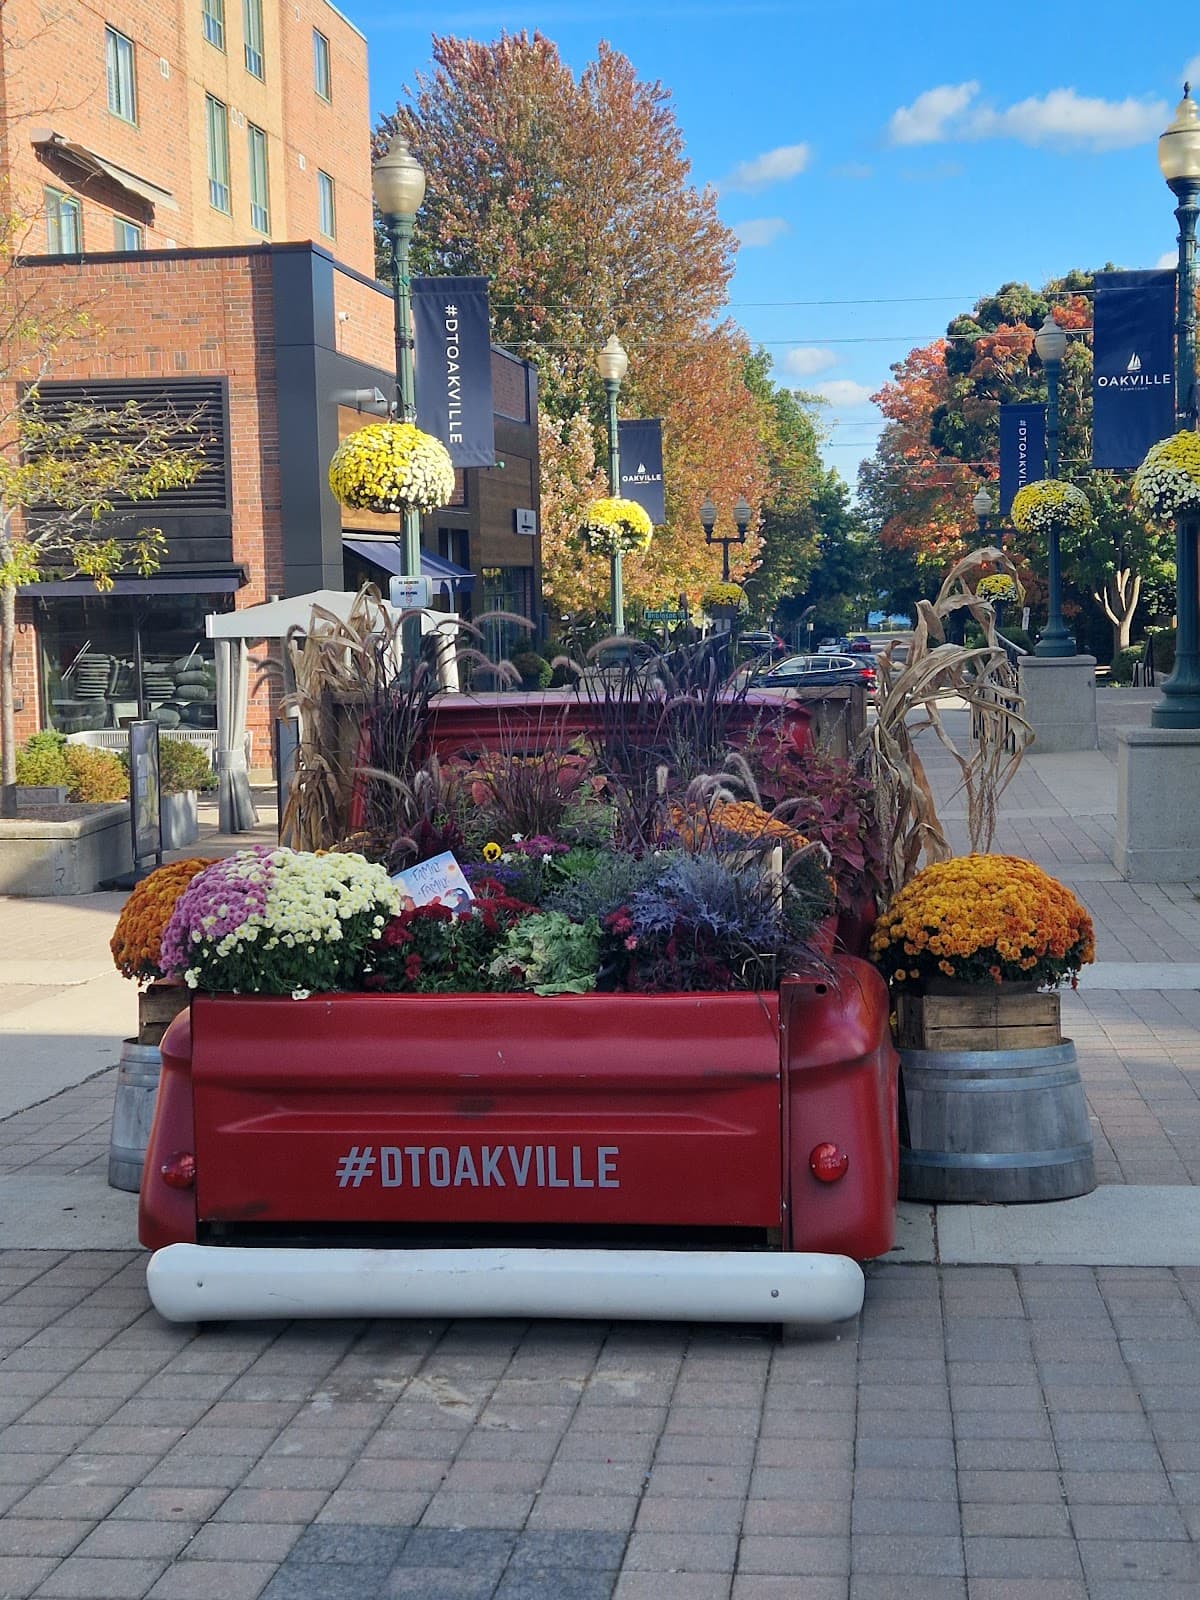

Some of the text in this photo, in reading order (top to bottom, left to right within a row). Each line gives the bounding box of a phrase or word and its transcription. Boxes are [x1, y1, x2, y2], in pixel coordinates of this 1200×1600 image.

[445, 304, 463, 444] #DTOAKVILLE
[1097, 374, 1171, 387] OAKVILLE
[622, 474, 662, 482] OAKVILLE
[335, 1145, 620, 1188] #DTOAKVILLE
